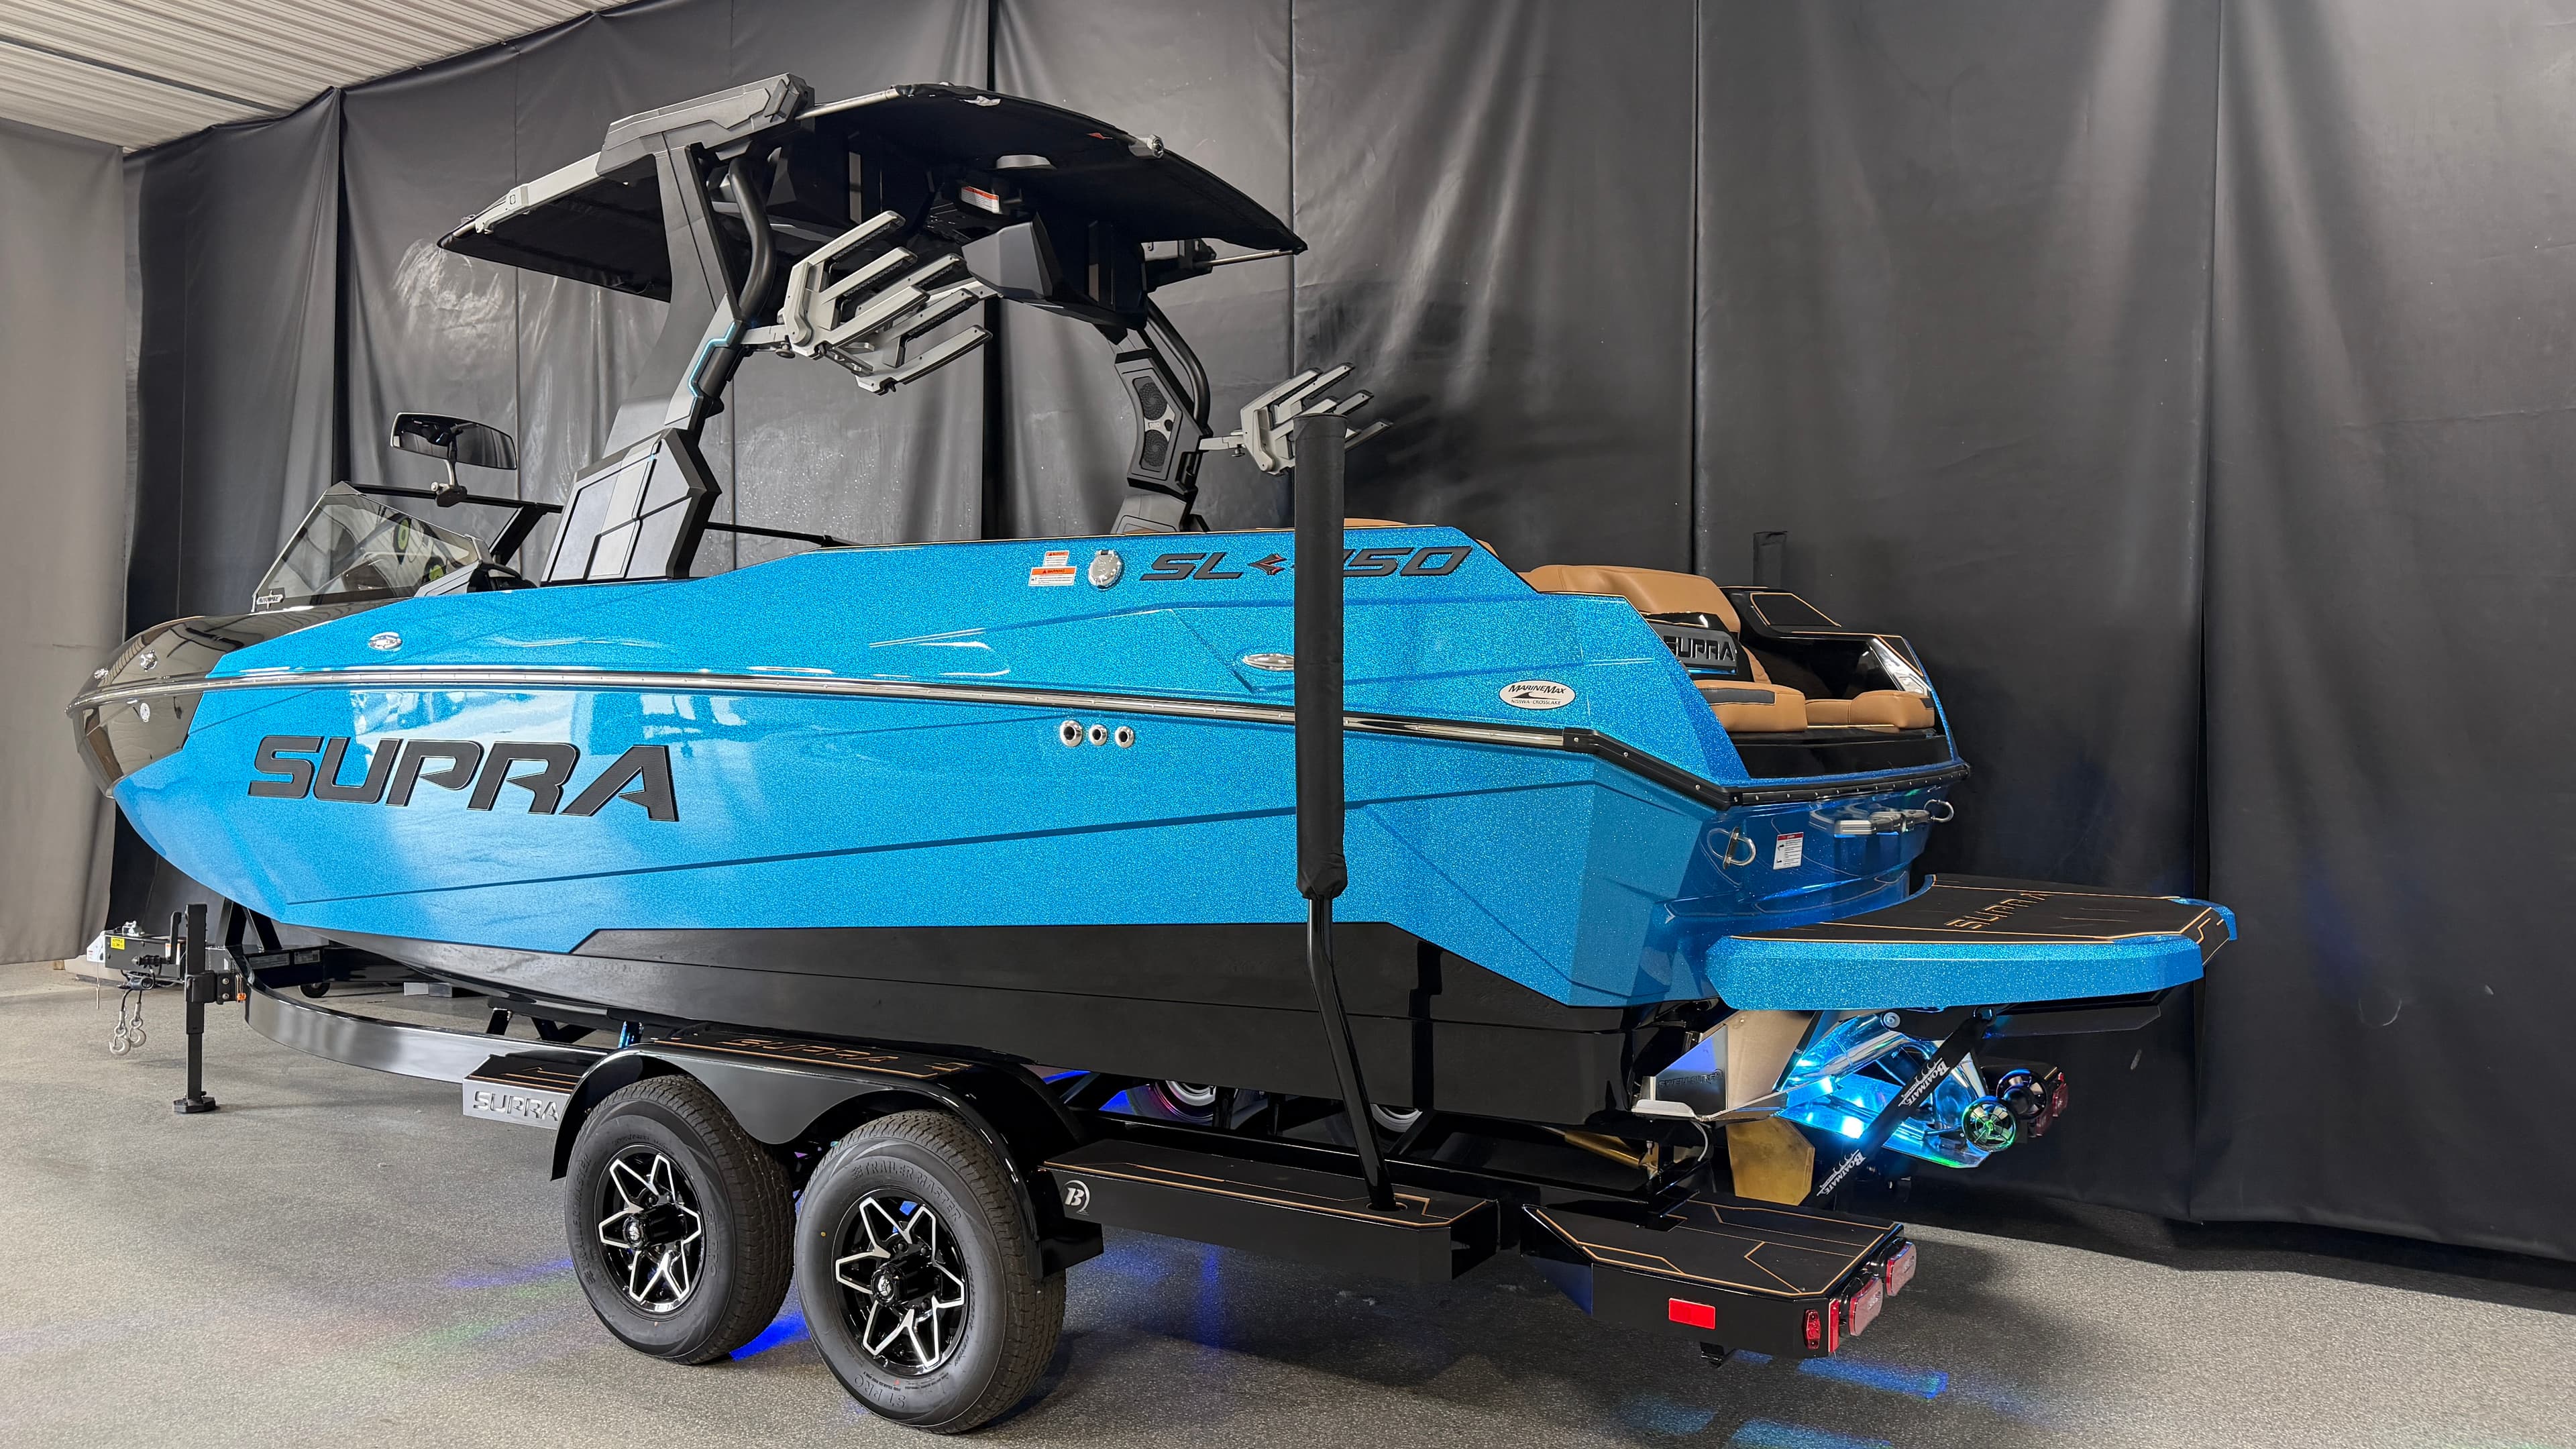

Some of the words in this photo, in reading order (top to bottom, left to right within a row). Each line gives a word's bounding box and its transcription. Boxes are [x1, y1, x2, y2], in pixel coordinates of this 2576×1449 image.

[1140, 551, 1244, 581] SL
[1342, 546, 1474, 578] 50
[1664, 635, 1735, 661] SUPRA
[247, 735, 680, 822] SUPRA
[1902, 1060, 1951, 1106] BOATMATE
[473, 1090, 559, 1122] SUPRA
[1821, 1150, 1867, 1195] BOATMATE
[916, 1173, 962, 1222] MASTER
